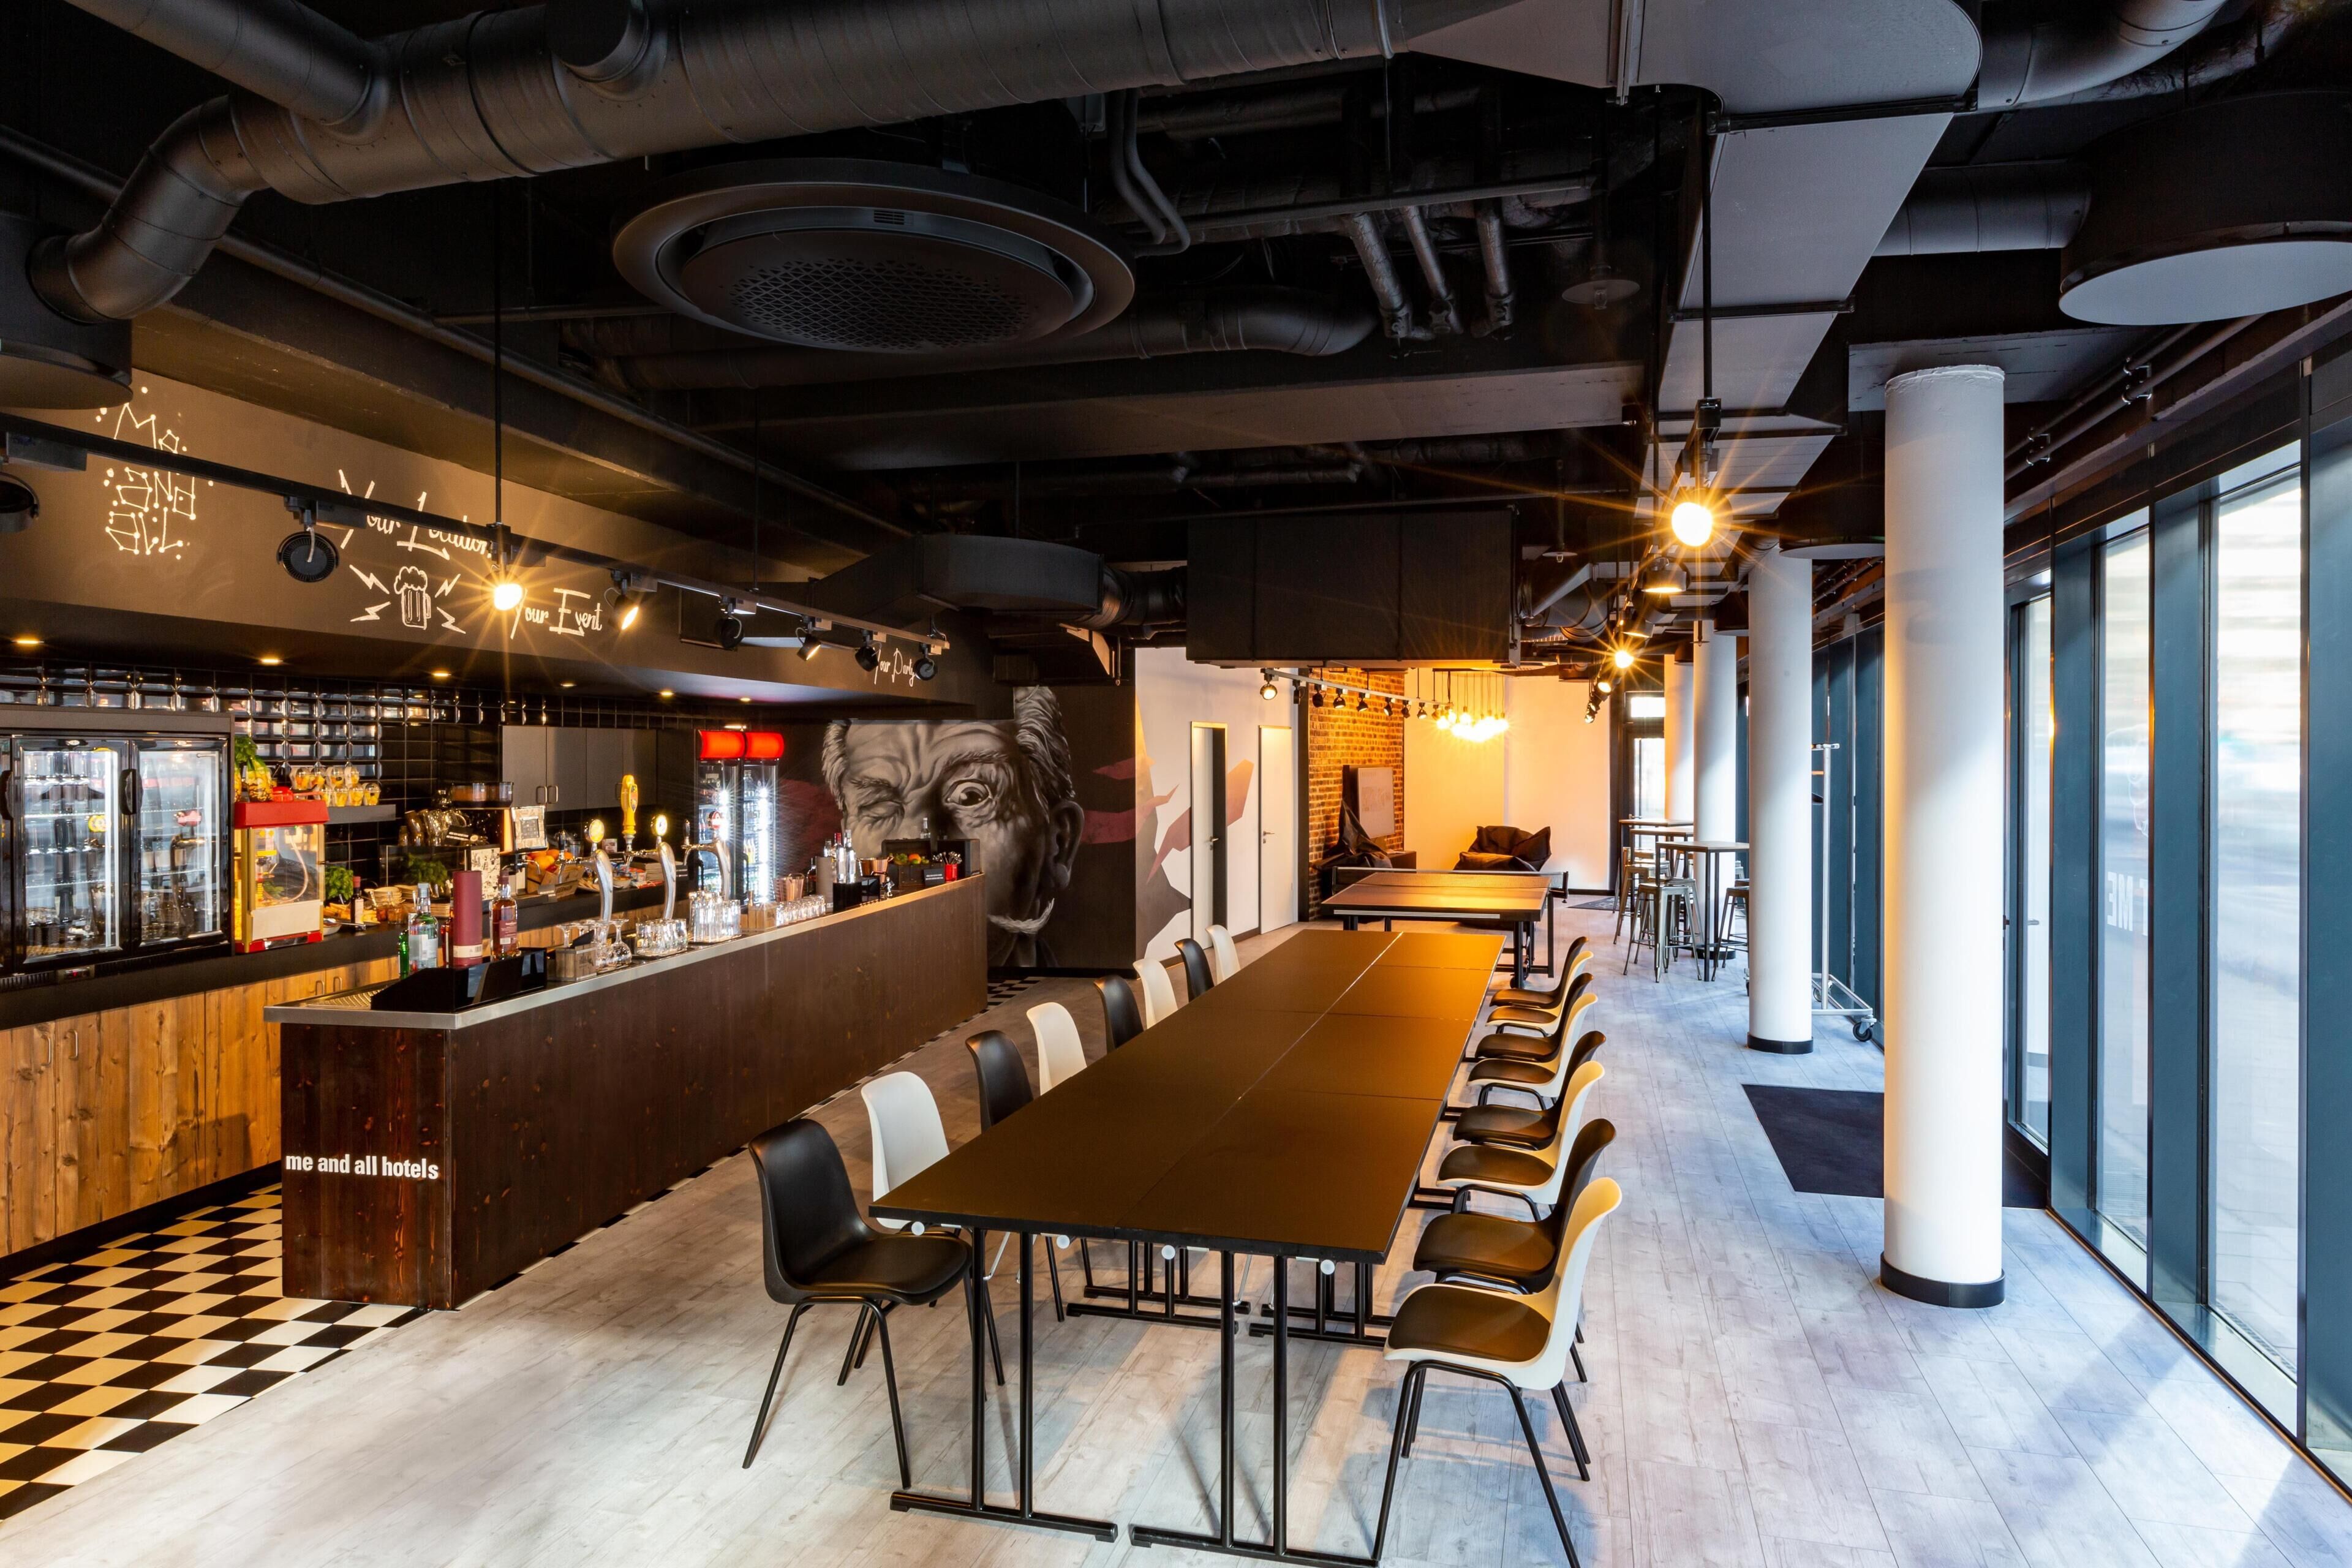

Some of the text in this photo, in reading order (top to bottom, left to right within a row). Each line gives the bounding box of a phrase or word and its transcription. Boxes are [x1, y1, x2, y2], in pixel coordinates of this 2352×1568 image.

[549, 587, 603, 637] Event
[892, 647, 916, 687] Party
[285, 1154, 439, 1180] me and all hotels
